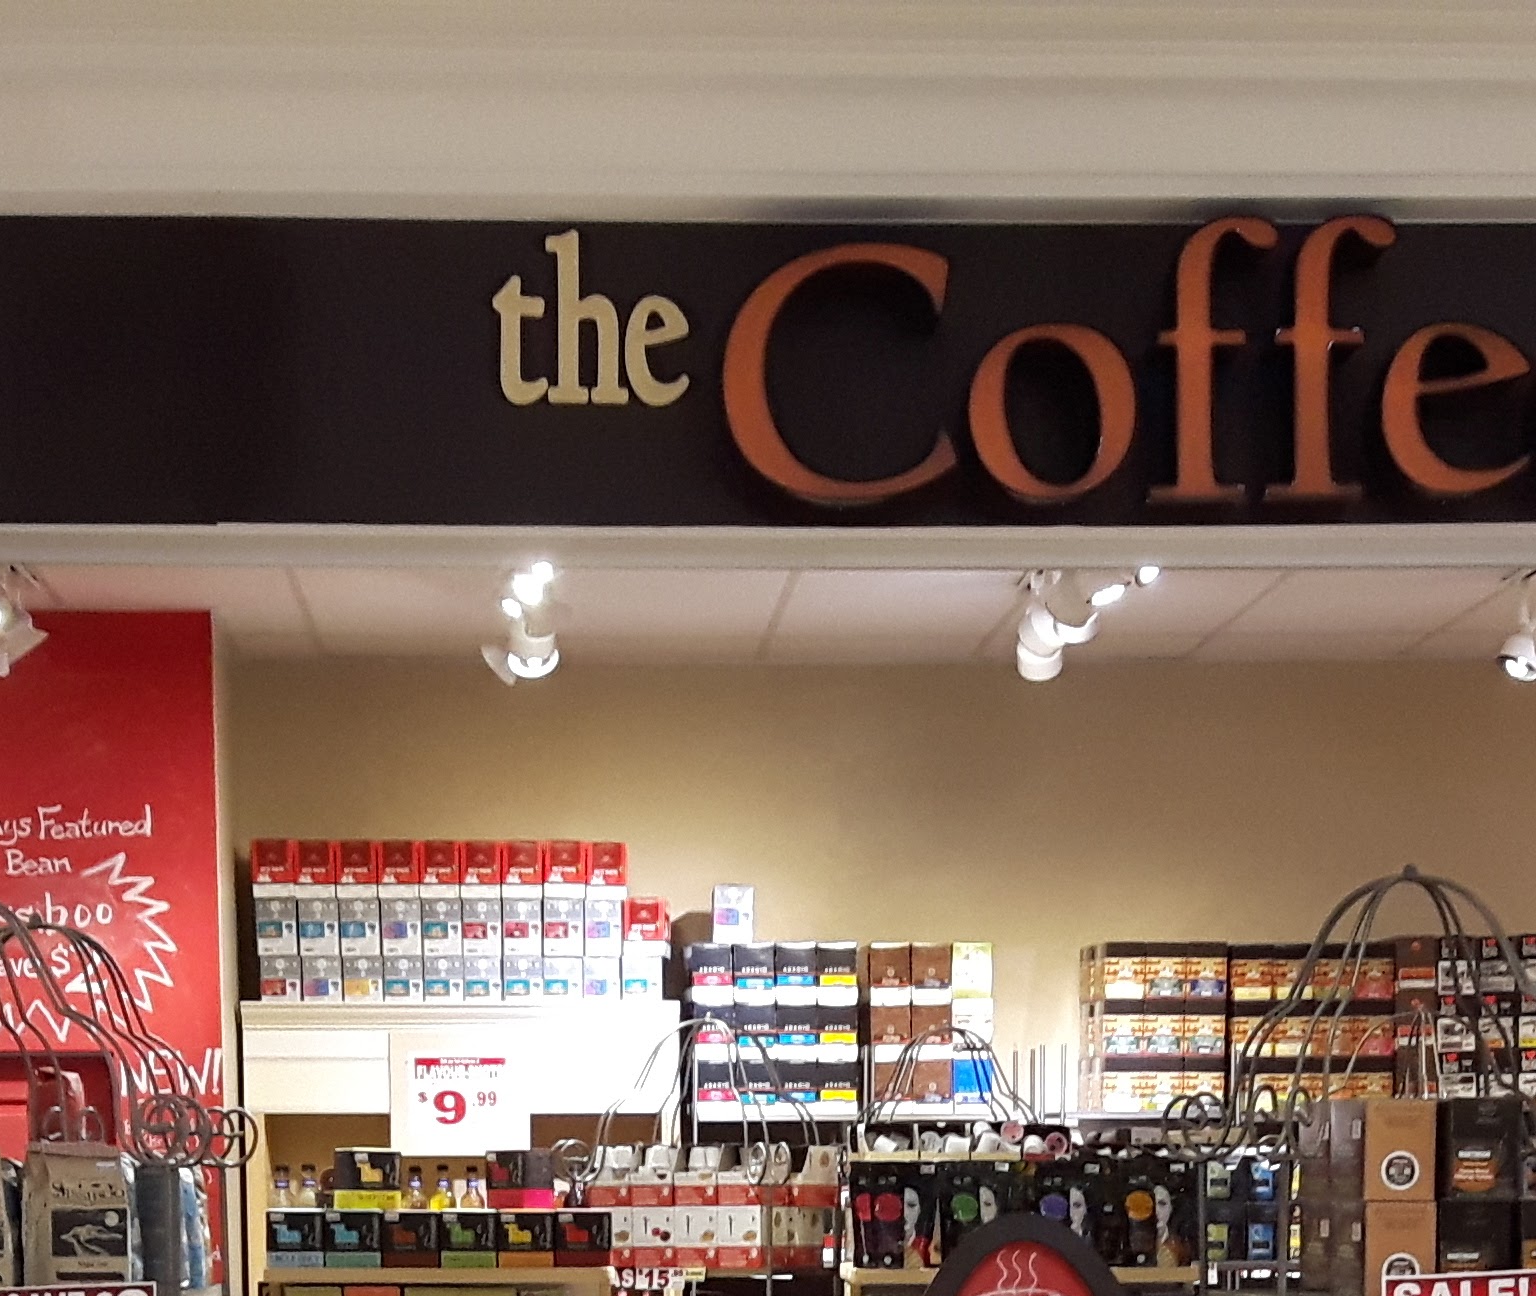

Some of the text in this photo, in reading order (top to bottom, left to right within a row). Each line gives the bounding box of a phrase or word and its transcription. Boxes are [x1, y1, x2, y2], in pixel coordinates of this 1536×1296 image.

[494, 230, 693, 411] the
[38, 802, 153, 841] Featured
[5, 848, 73, 876] Bean
